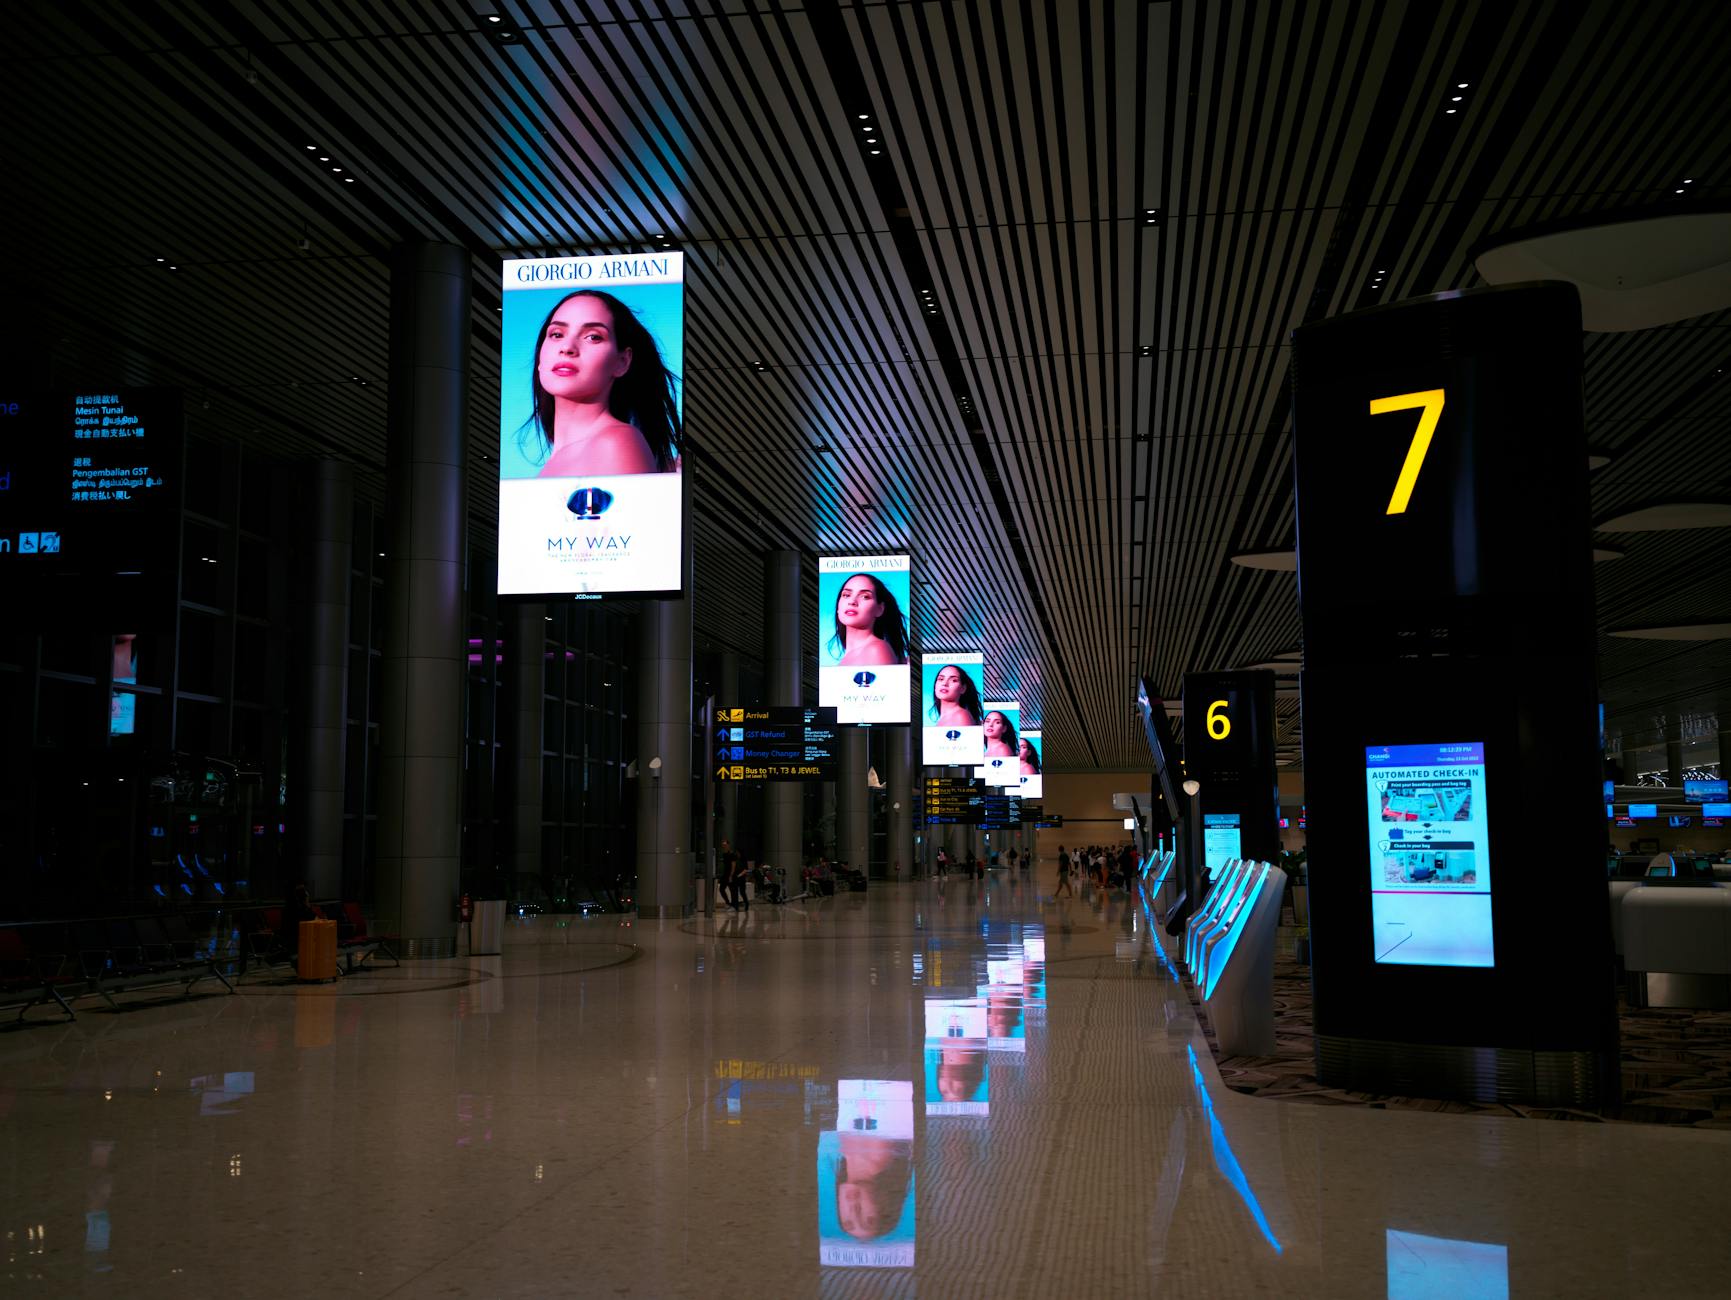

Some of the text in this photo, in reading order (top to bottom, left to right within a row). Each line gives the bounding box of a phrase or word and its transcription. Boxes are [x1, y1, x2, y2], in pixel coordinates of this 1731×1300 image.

[517, 258, 668, 282] GIORGIO ARMANI
[75, 405, 124, 415] Mesin Tunai
[1370, 388, 1445, 515] 7
[72, 467, 148, 478] Pengembalian GST
[547, 535, 631, 551] MY WAY
[826, 558, 902, 569] GIORGIO ARMANI
[863, 694, 886, 702] WAY
[1206, 700, 1231, 740] 6
[745, 750, 769, 758] Money
[771, 750, 800, 758] Changer
[768, 767, 779, 775] T1,
[1372, 768, 1479, 779] AUTOMATED CHECK-IN
